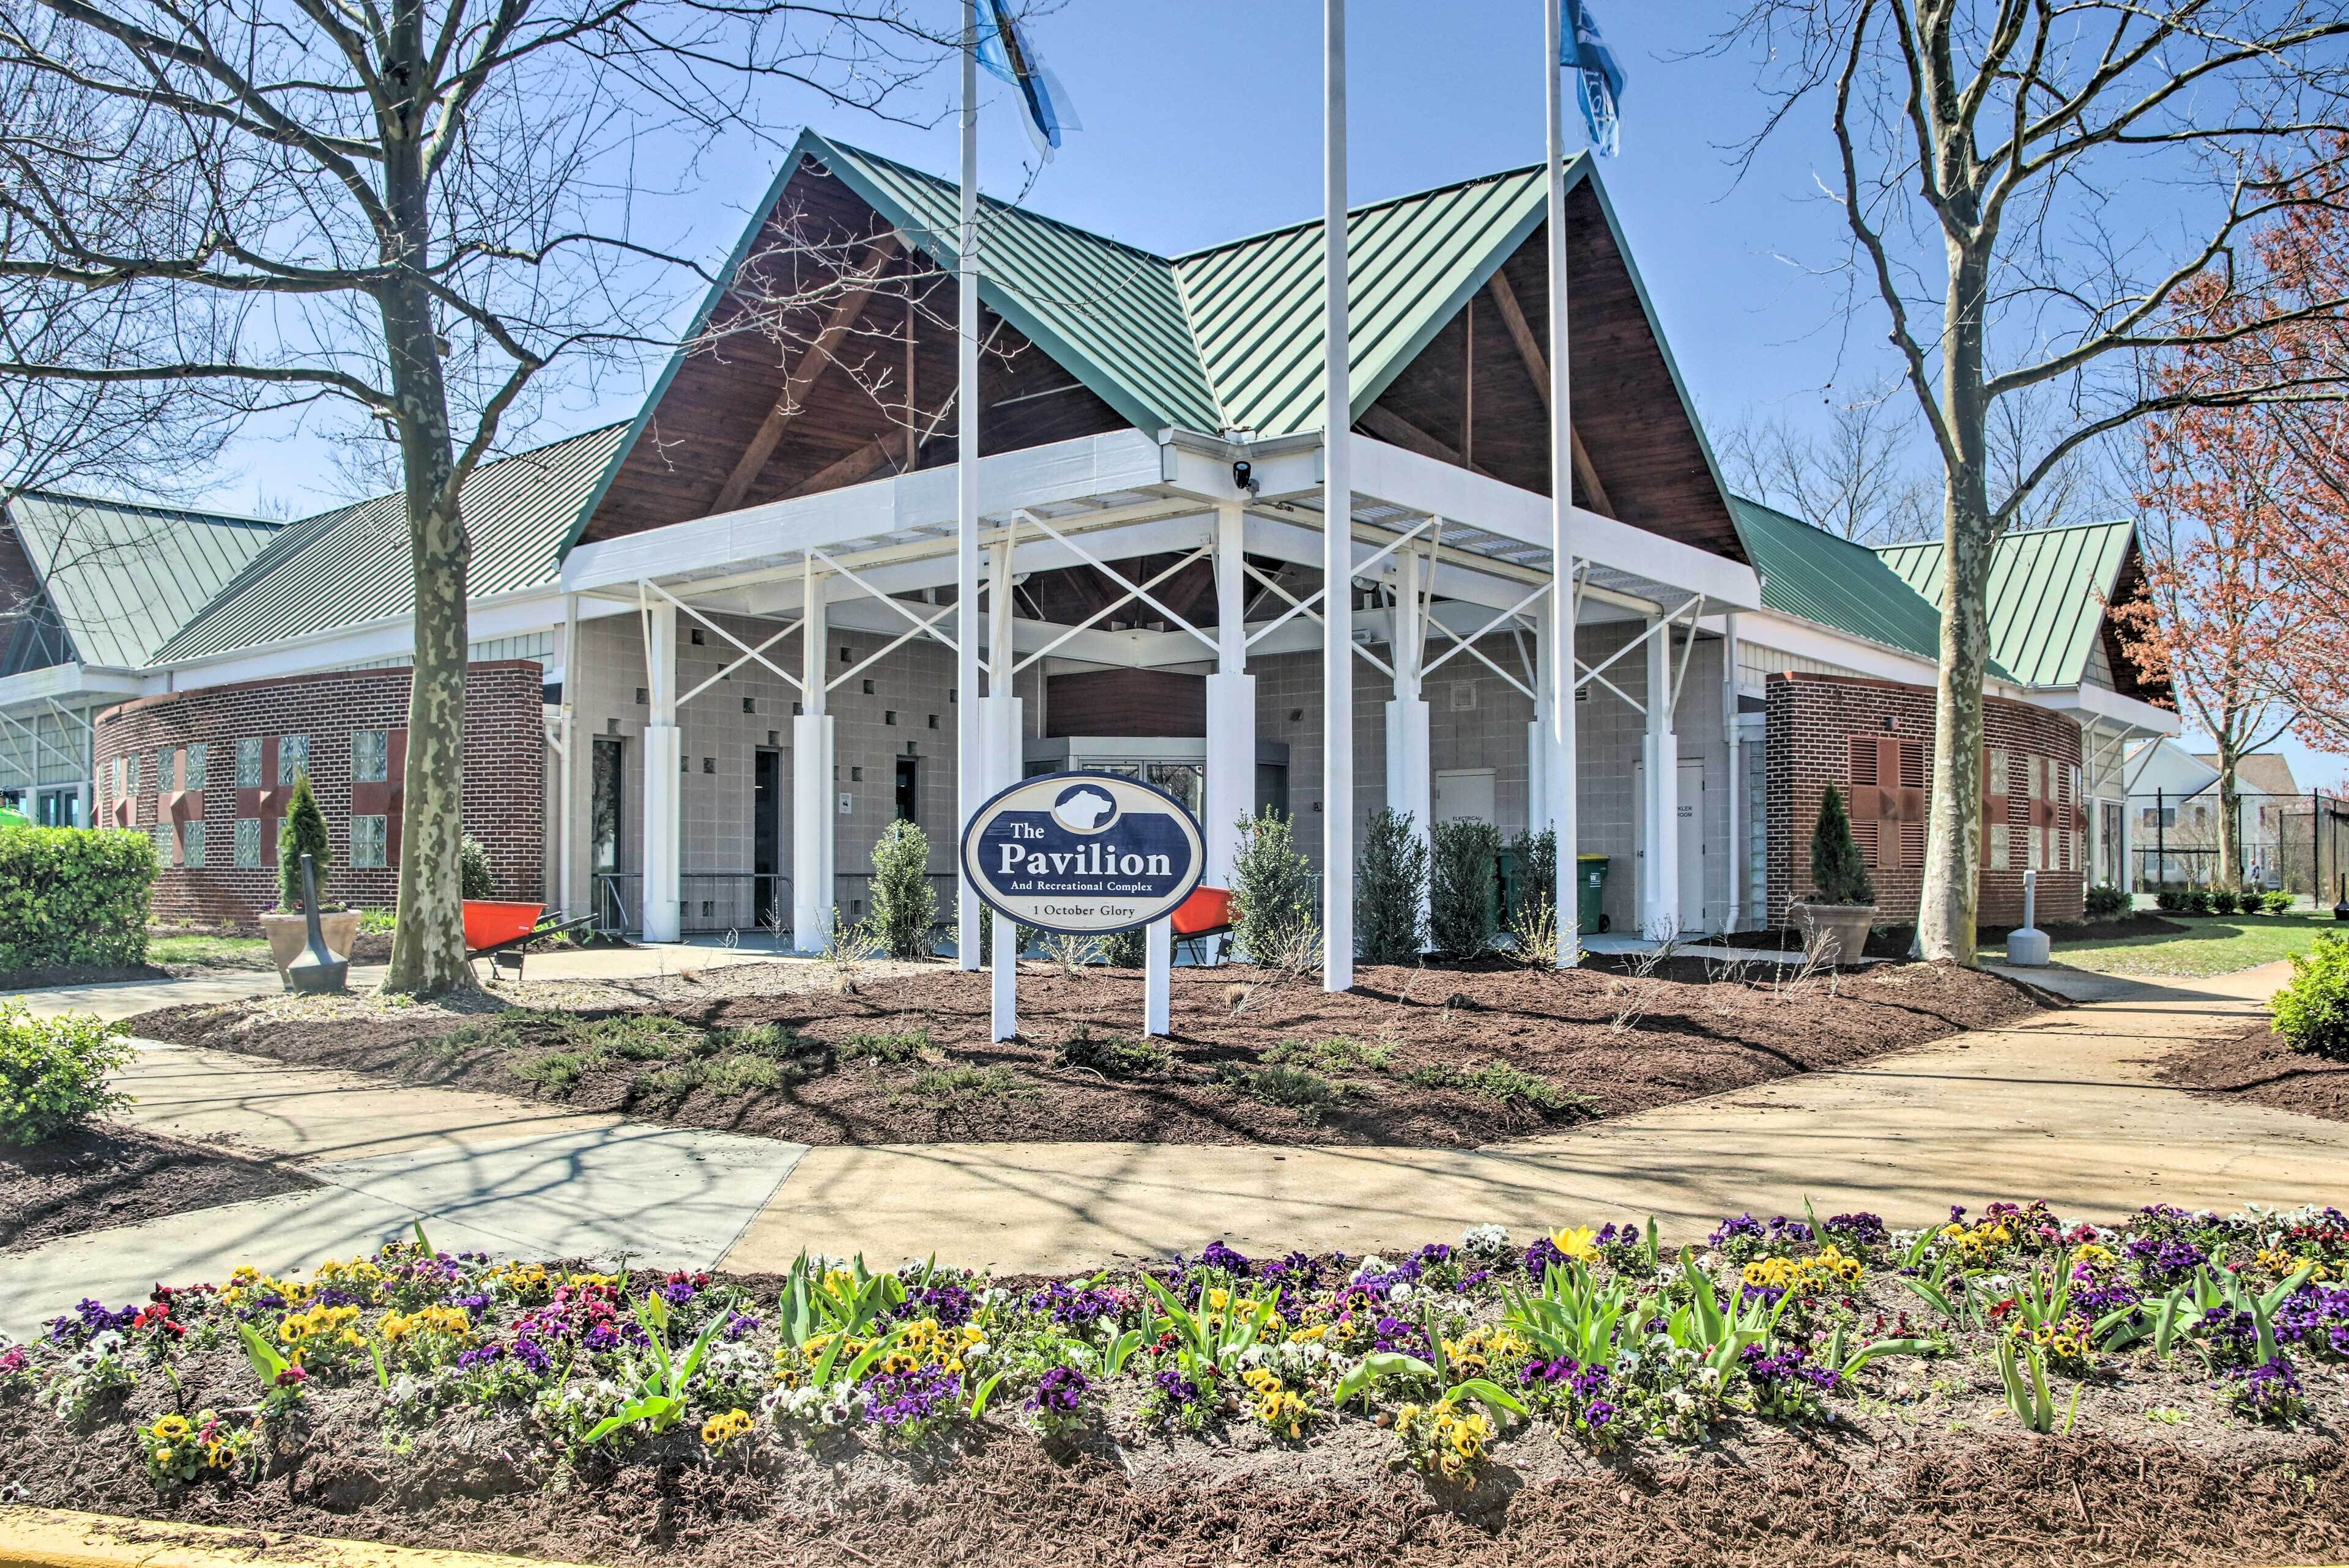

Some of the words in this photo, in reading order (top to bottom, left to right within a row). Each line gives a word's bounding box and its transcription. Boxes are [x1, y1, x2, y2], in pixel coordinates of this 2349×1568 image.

[1010, 823, 1045, 839] The
[998, 843, 1172, 876] Pavilion
[1011, 881, 1033, 890] And
[1037, 881, 1102, 891] Recreational
[1107, 882, 1152, 893] Complex
[1034, 906, 1038, 915] 1
[1044, 905, 1094, 915] October
[1100, 906, 1135, 918] Glory
